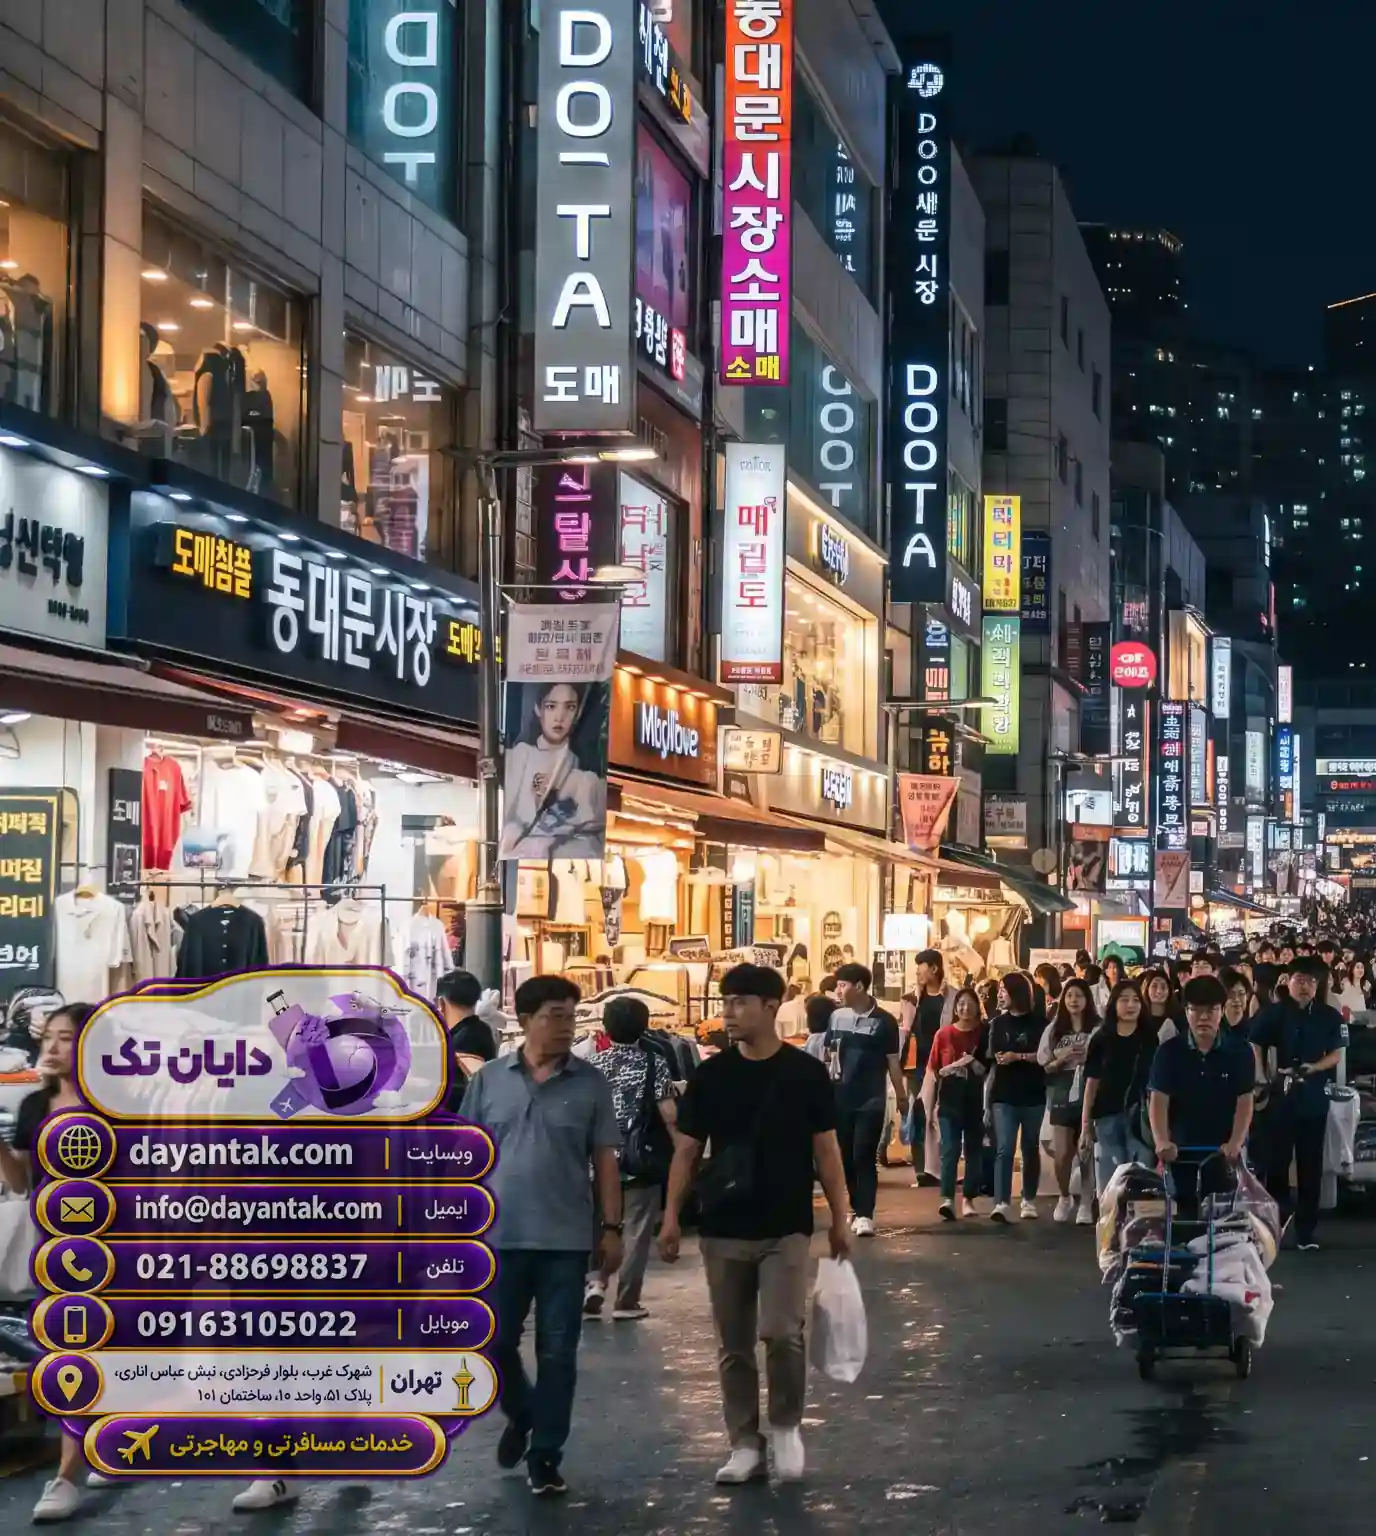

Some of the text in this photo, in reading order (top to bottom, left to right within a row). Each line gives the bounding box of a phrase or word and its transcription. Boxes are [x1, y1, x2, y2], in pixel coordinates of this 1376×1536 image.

[543, 364, 619, 404] 도매
[726, 356, 780, 381] 소매
[903, 365, 938, 568] DOOTA
[267, 548, 437, 688] 동대문시장
